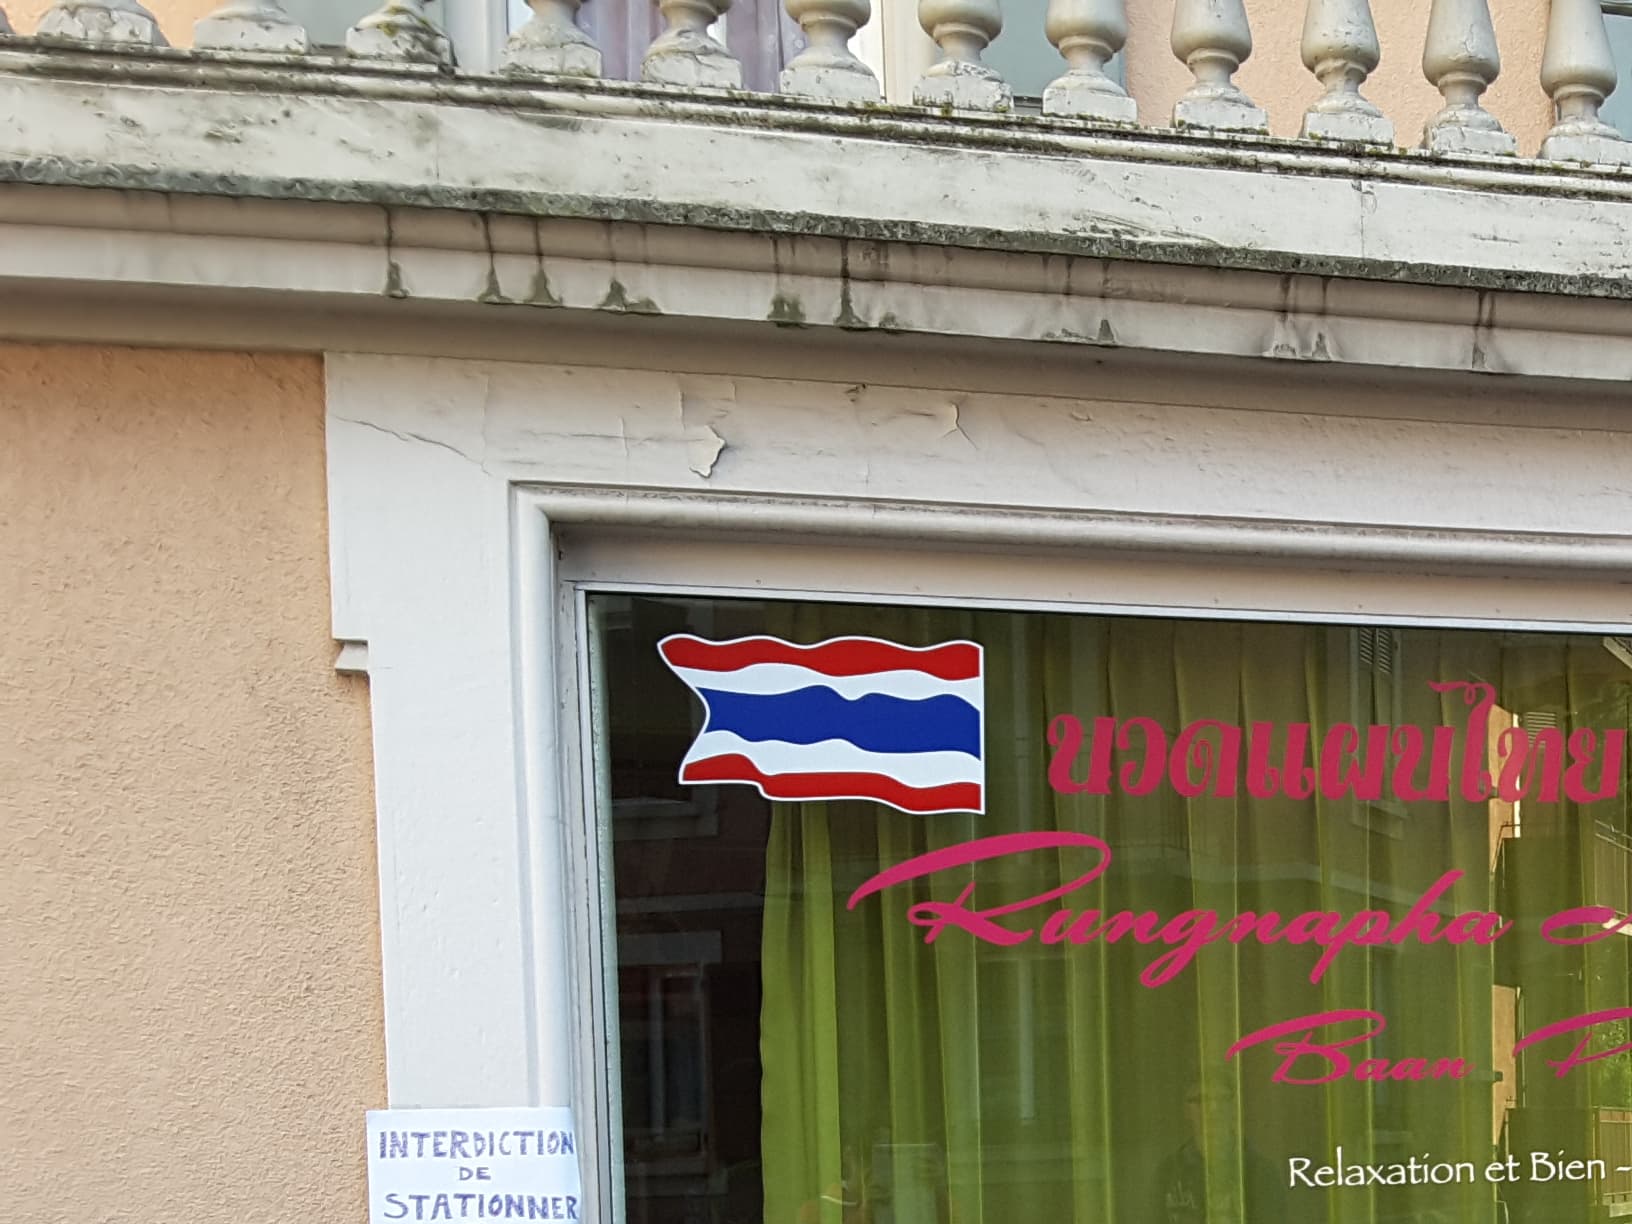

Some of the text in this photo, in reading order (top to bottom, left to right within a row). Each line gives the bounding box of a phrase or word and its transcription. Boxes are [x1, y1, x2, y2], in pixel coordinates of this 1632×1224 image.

[846, 831, 1513, 988] Rungnapha
[1227, 1009, 1471, 1085] Baan
[379, 1129, 574, 1159] INTERDICTION
[459, 1166, 491, 1181] DE
[1289, 1146, 1475, 1187] Relaxation
[1484, 1157, 1521, 1182] et
[1530, 1150, 1606, 1182] Bien
[383, 1192, 579, 1221] STATIONNER
